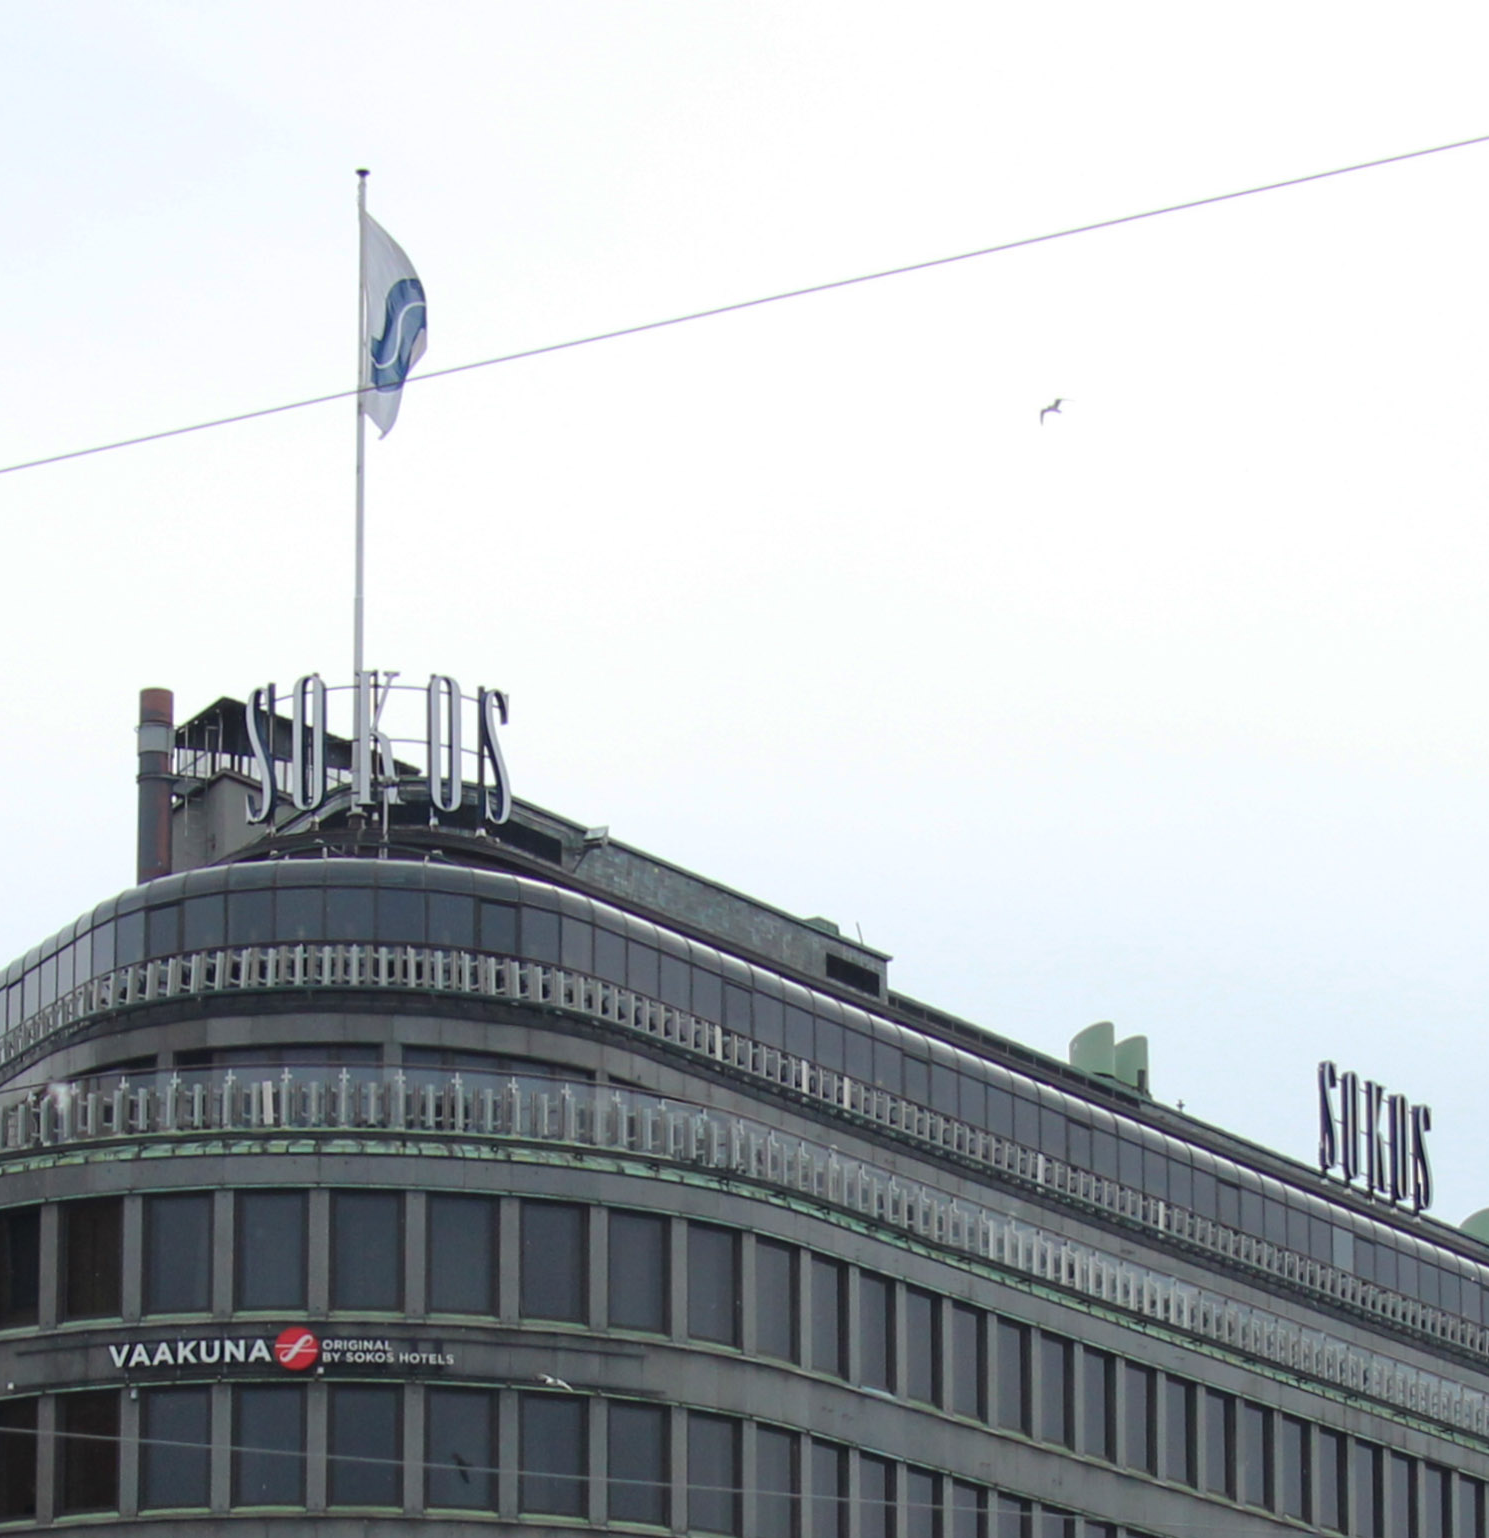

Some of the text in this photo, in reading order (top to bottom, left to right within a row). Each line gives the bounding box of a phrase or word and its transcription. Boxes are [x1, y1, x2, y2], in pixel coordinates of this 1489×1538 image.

[245, 669, 512, 825] SOKOS
[1317, 1060, 1434, 1211] SOKOS
[109, 1338, 272, 1368] VAAKUNA
[322, 1339, 393, 1351] ORIGINAL
[322, 1351, 455, 1365] BY SOKOS HOTELS
